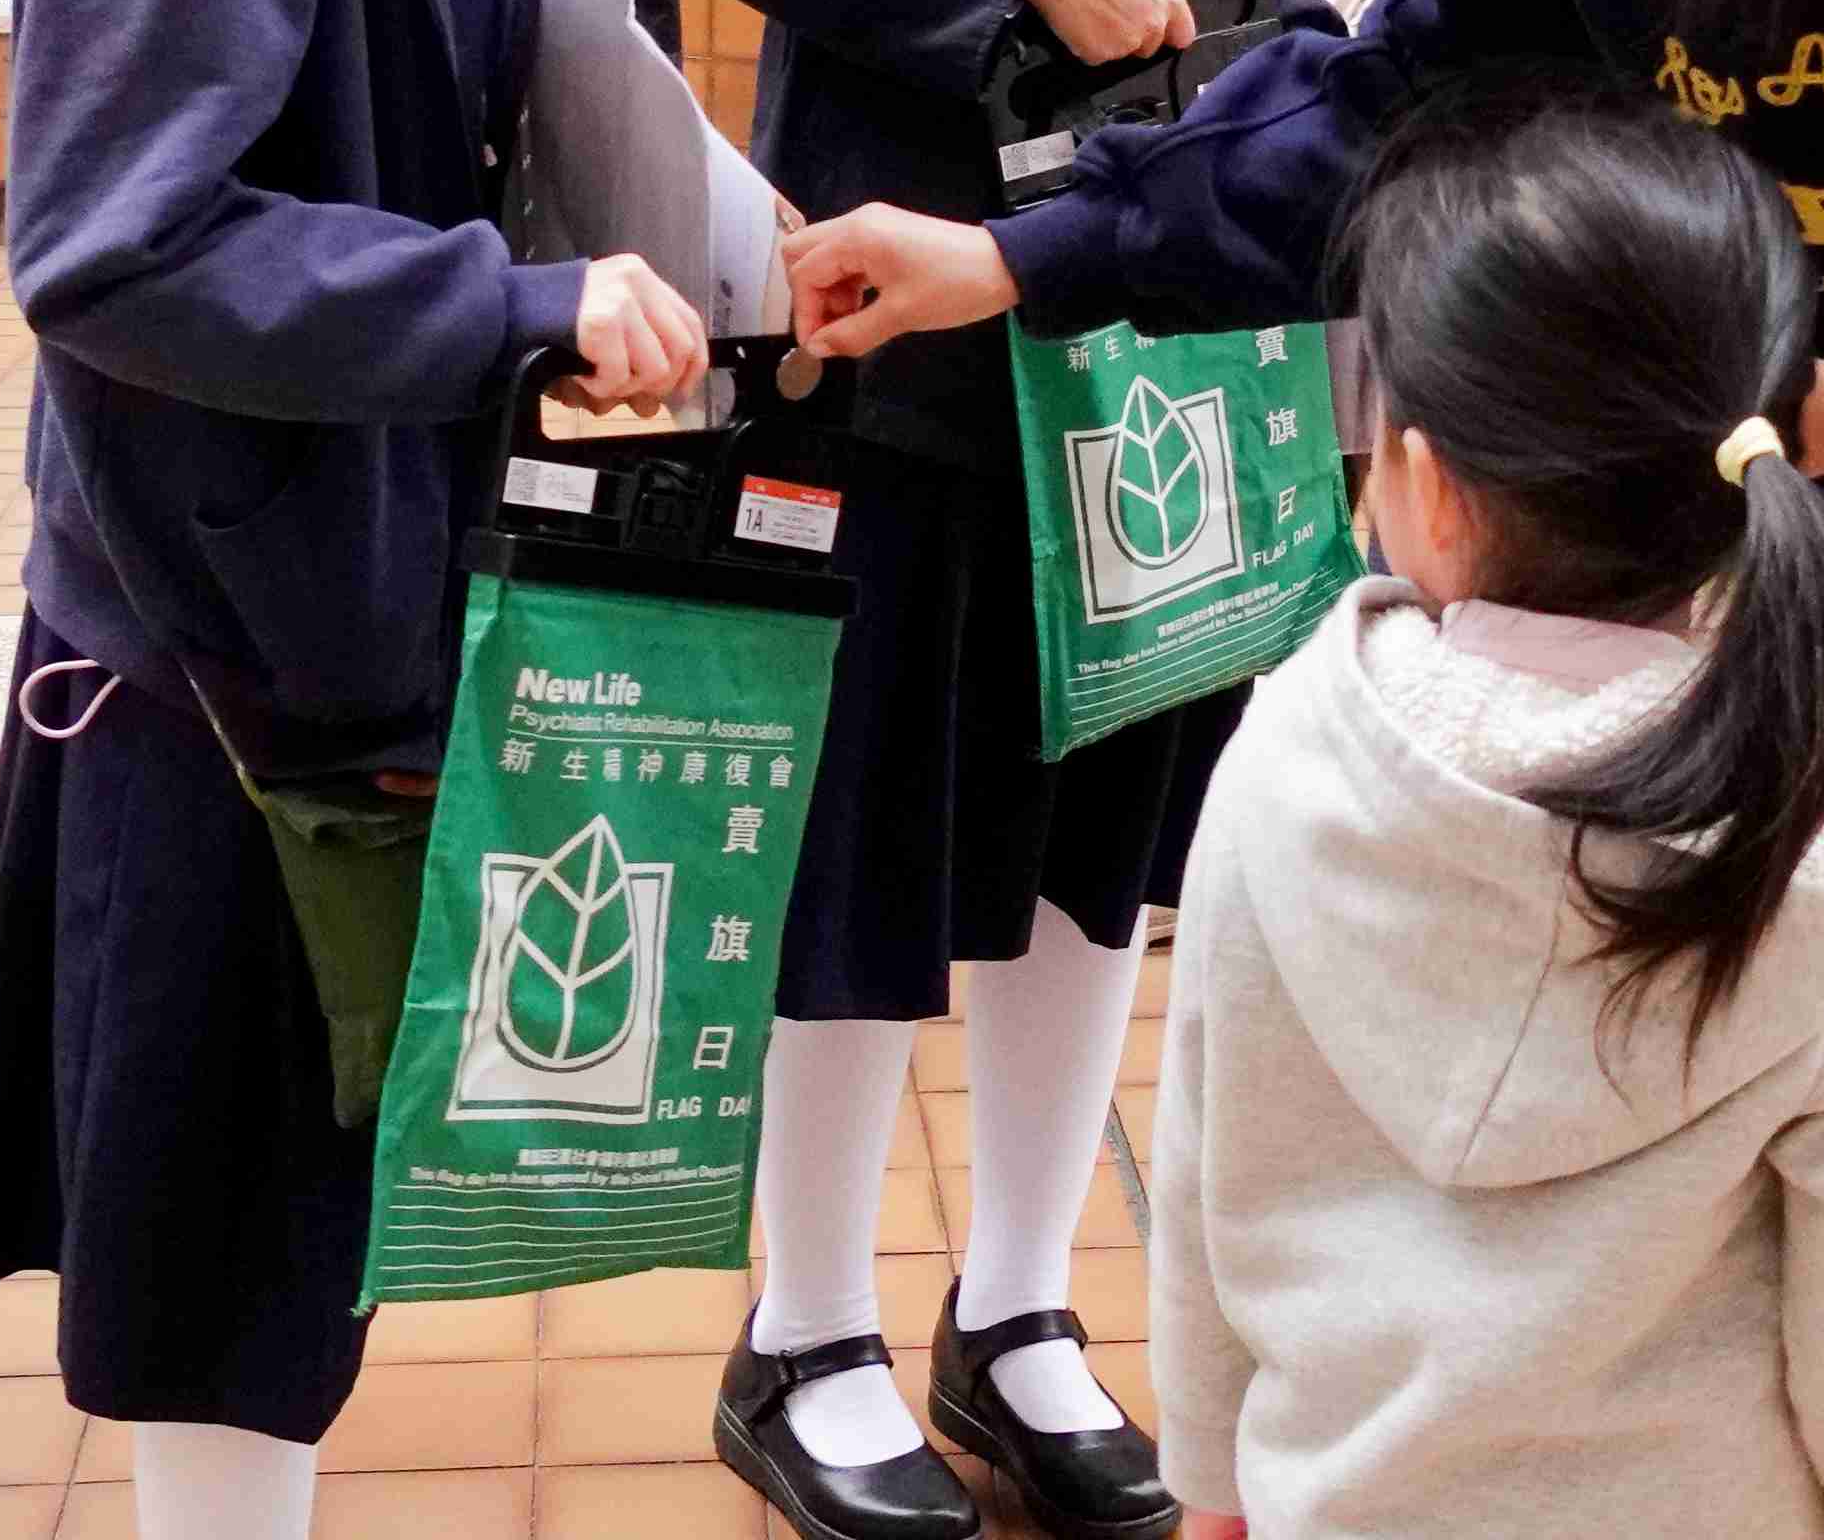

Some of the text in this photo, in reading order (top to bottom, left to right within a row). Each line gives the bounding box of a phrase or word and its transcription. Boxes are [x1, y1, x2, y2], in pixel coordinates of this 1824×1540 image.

[1252, 521, 1315, 568] FLAG DAY
[516, 667, 642, 707] New Life
[691, 804, 764, 1070] 賣旗日
[656, 1093, 751, 1120] FLAG DA
